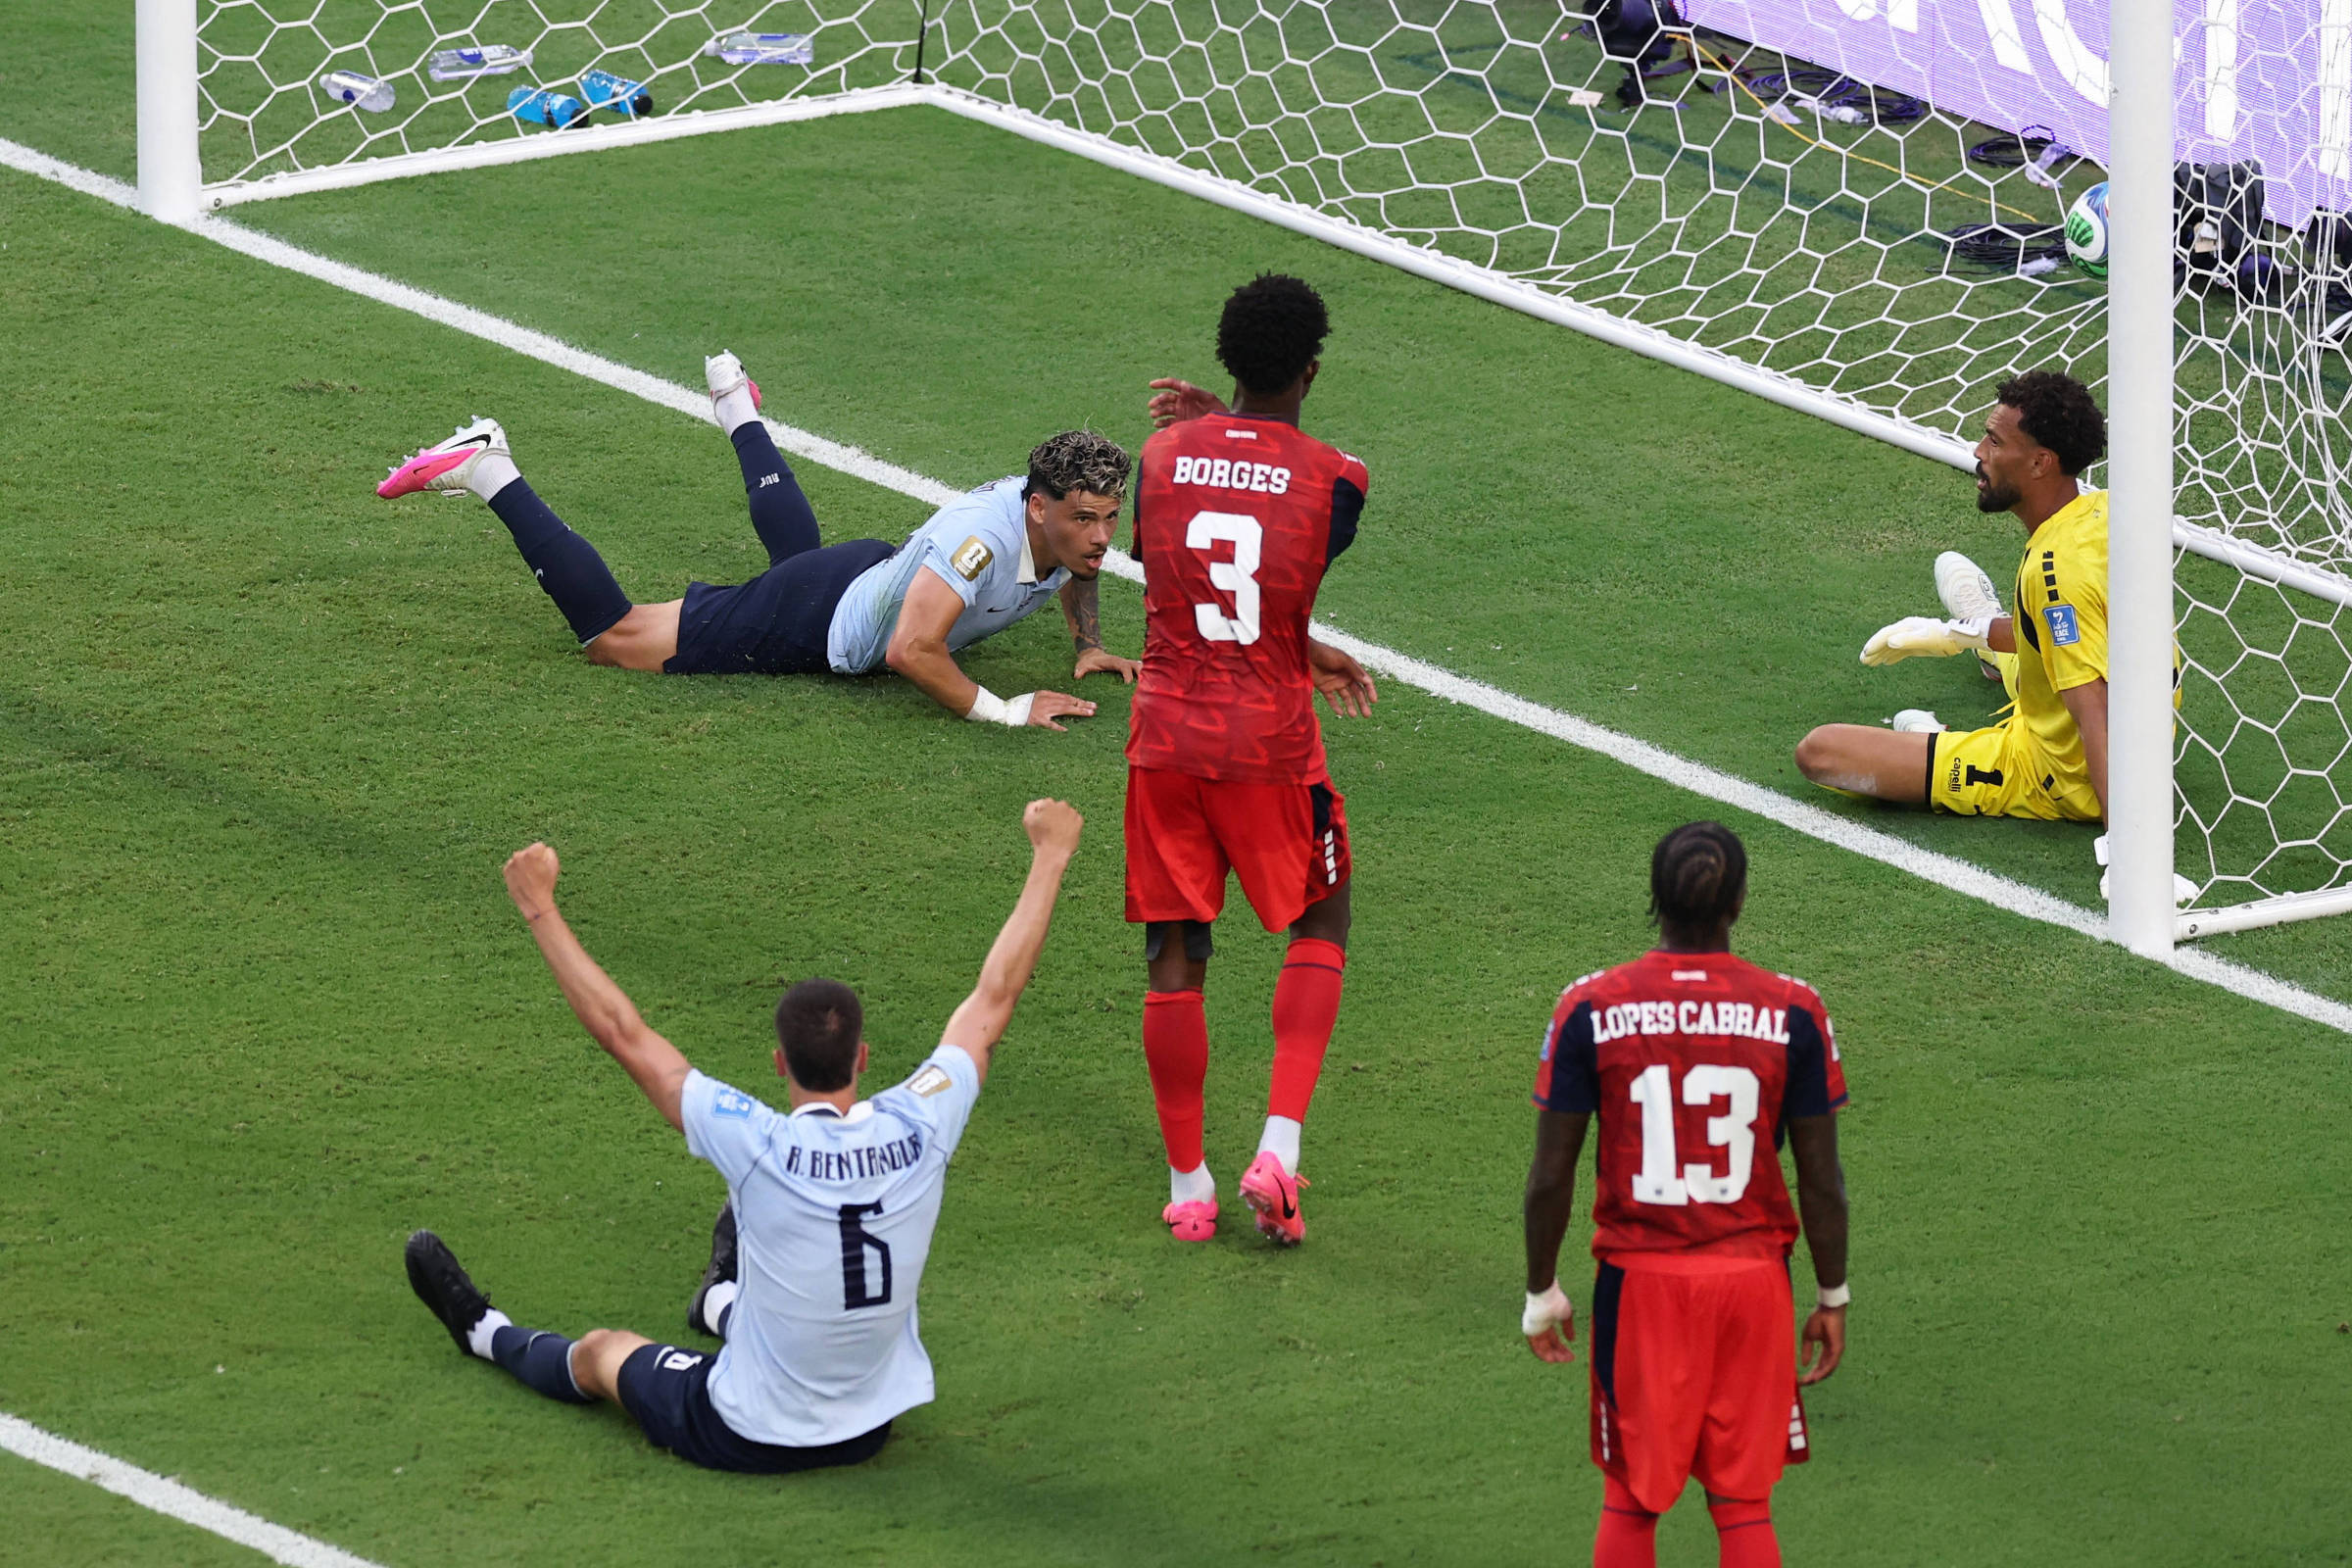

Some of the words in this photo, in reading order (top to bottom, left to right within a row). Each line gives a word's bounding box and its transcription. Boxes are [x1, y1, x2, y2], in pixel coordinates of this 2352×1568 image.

[1173, 456, 1292, 495] BORGES
[1186, 510, 1263, 646] 3
[1950, 757, 1962, 793] capelli
[1965, 764, 2004, 787] 1
[1590, 1001, 1678, 1045] LOPES
[1679, 1001, 1790, 1045] CABRAL
[1630, 1064, 1759, 1206] 13
[838, 1199, 892, 1311] 6
